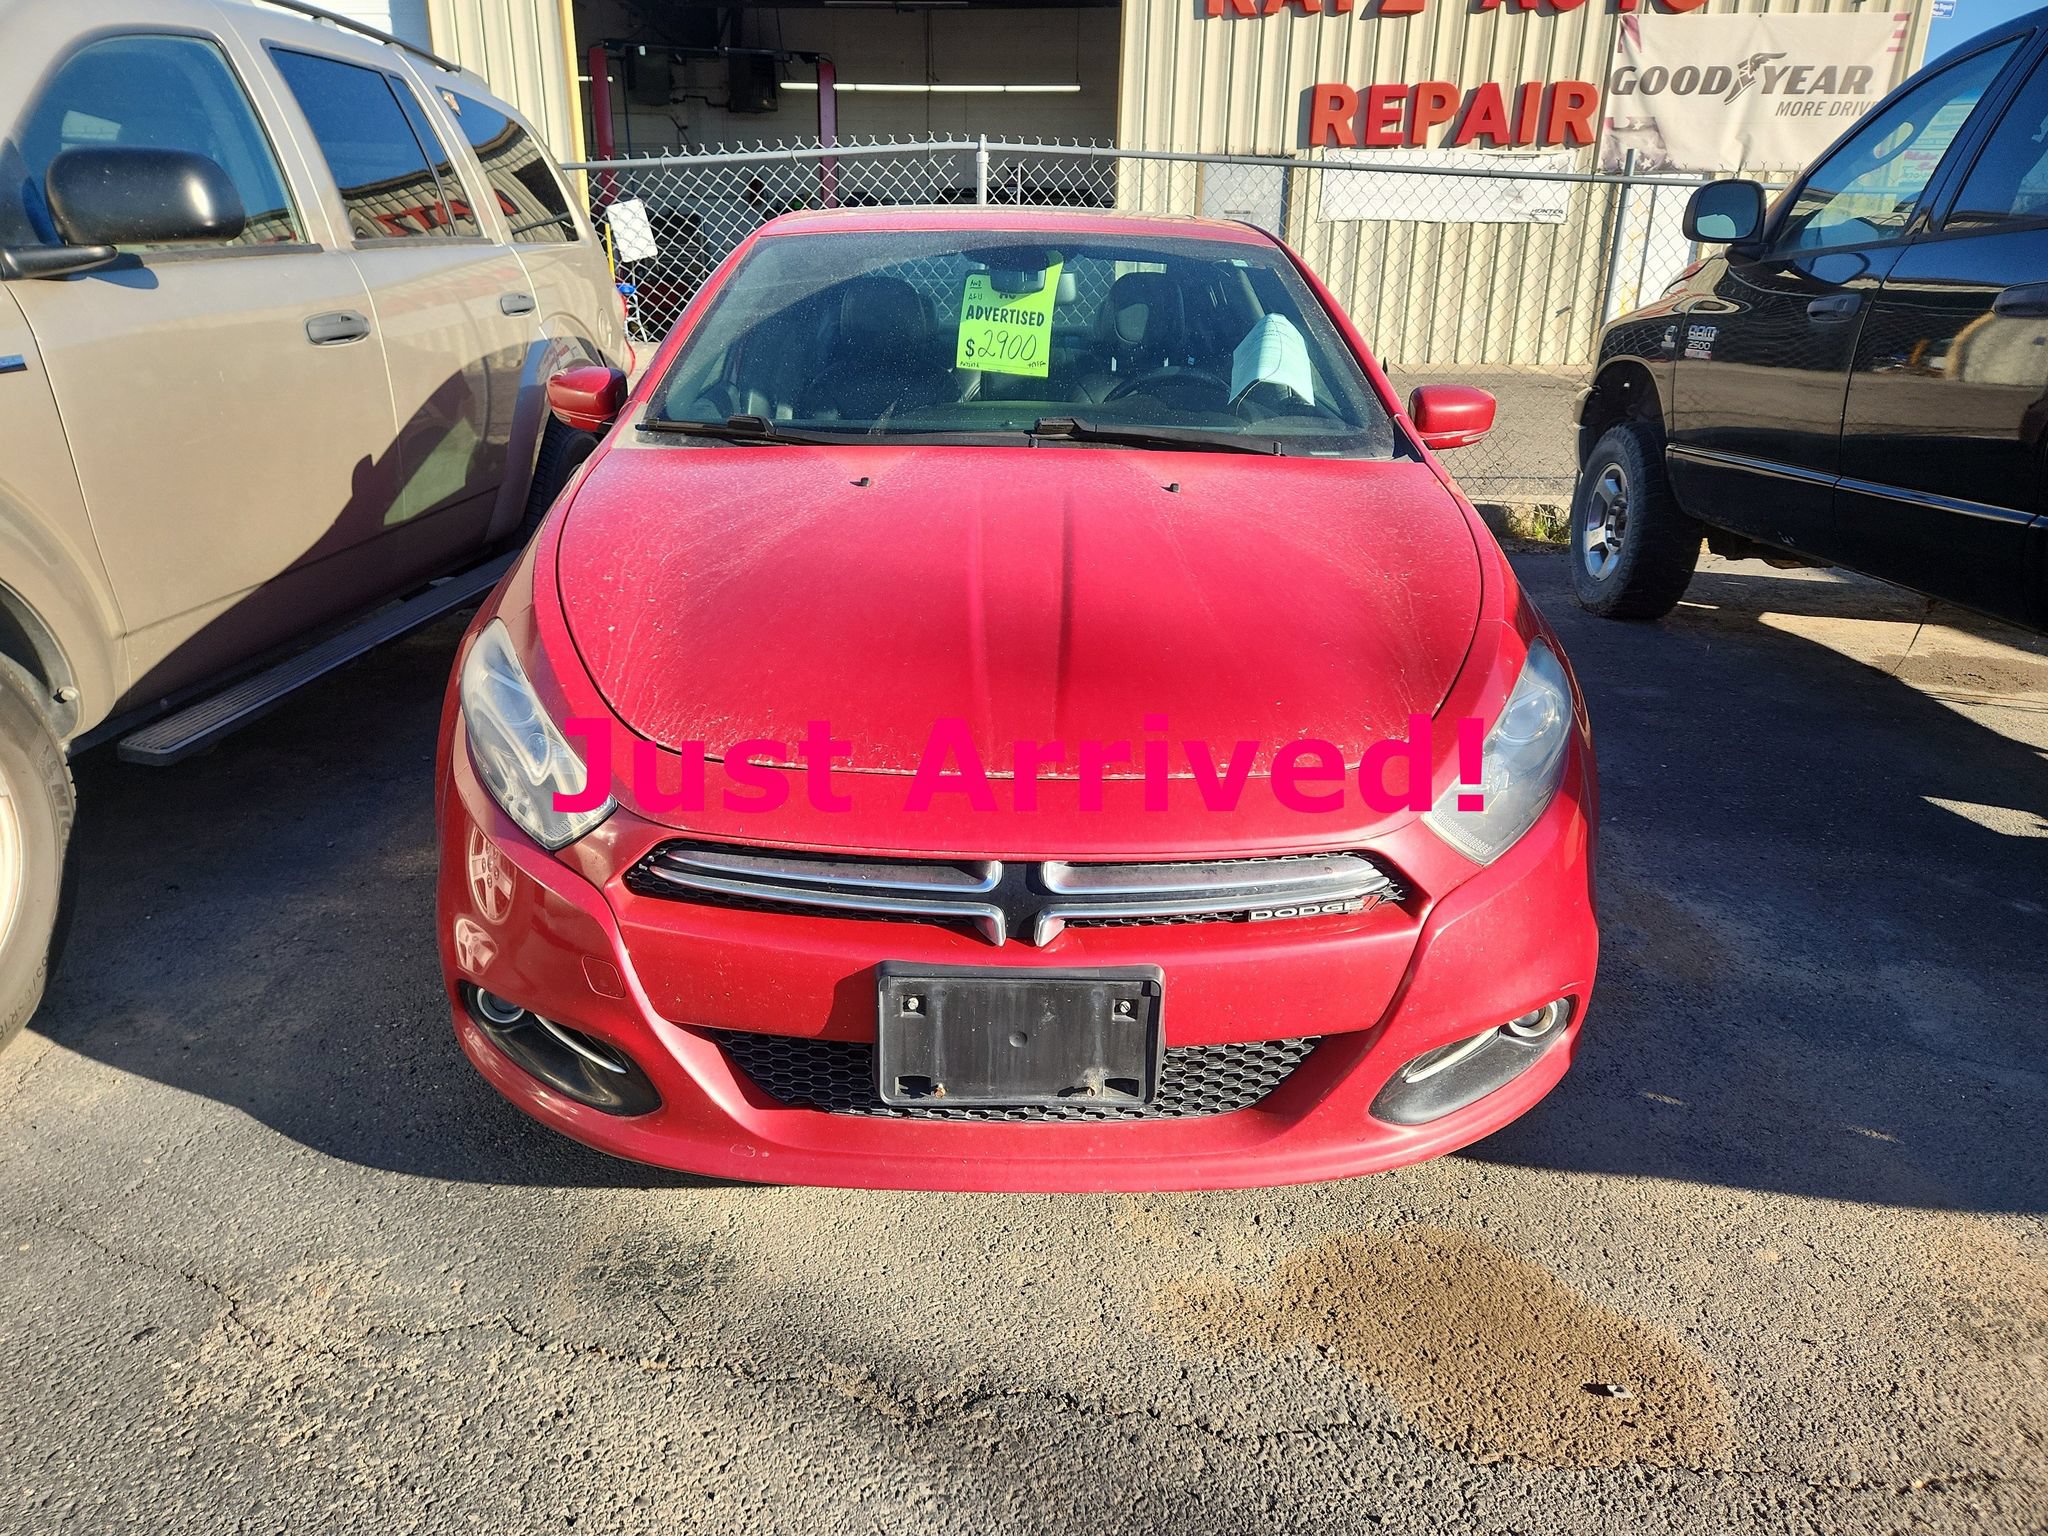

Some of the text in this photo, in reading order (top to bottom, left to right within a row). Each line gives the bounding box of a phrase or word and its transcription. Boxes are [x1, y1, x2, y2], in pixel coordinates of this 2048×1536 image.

[1309, 80, 1599, 146] REPAIR
[1774, 100, 1878, 117] MORE DRIV
[965, 304, 1045, 328] ADVERTISED
[1687, 340, 1711, 351] 2500
[1250, 899, 1364, 920] DODGE
